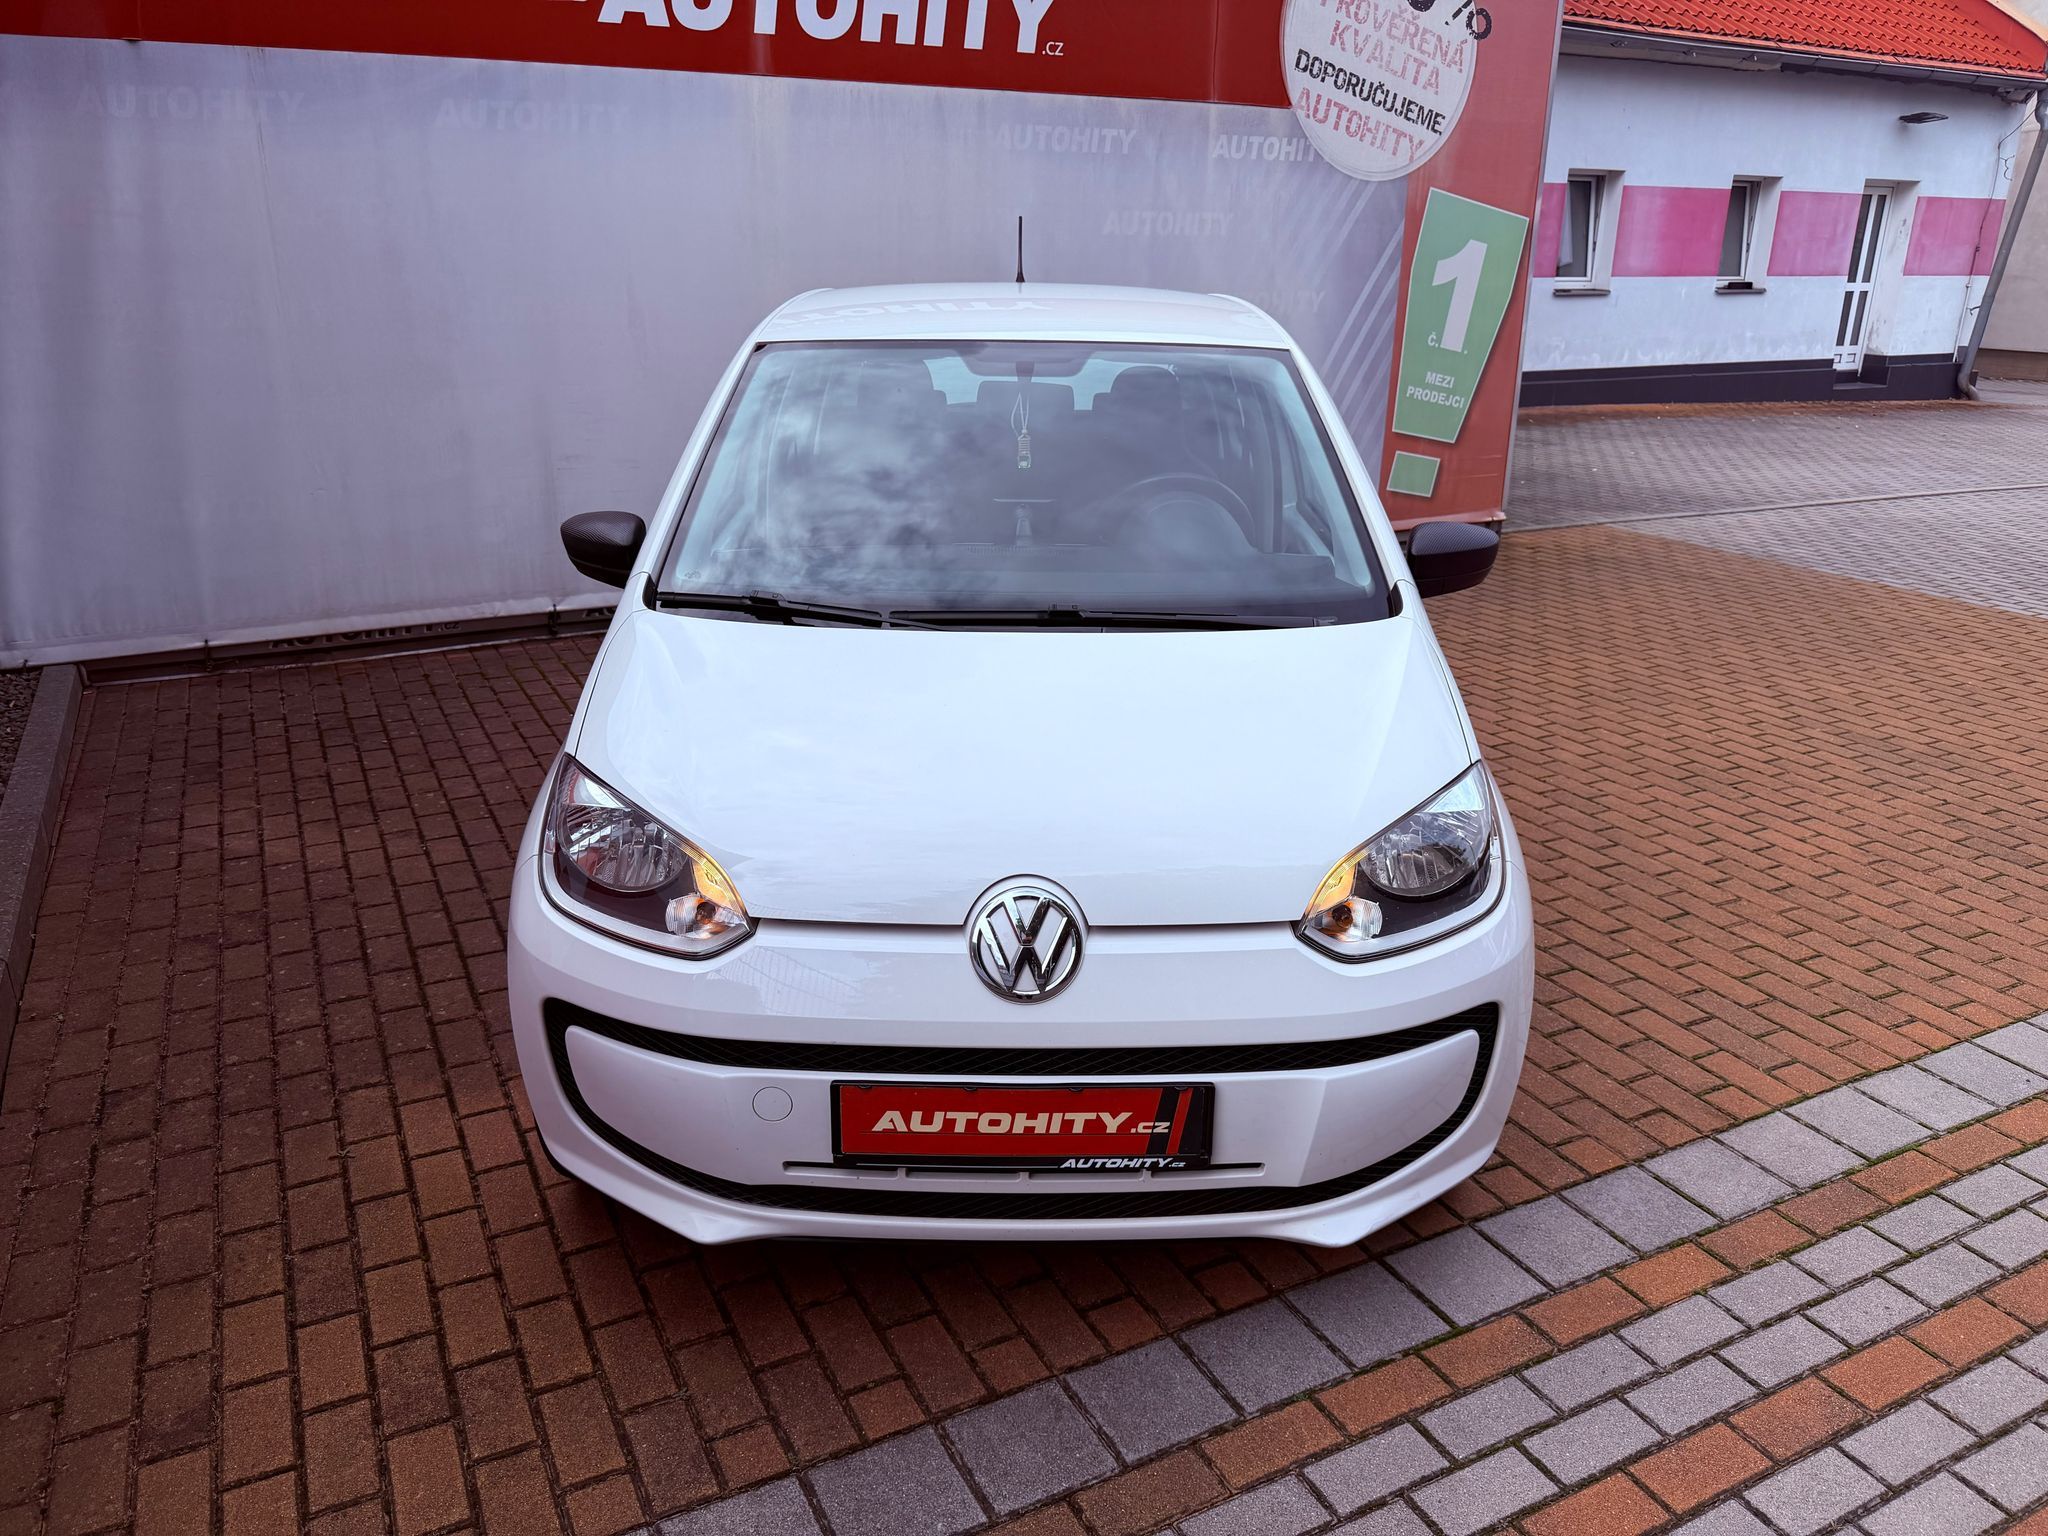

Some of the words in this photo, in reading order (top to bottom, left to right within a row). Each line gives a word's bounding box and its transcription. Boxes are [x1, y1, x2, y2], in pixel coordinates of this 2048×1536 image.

[1320, 0, 1467, 74] ROVĚŘENÁ
[1330, 19, 1441, 96] KVALITA
[1294, 48, 1446, 136] DOPORUČUJEME
[996, 123, 1138, 154] AUTOHITY
[1296, 87, 1426, 163] AUTOHITY
[1211, 135, 1315, 162] AUTOHIT
[1101, 209, 1234, 238] AUTOHITY
[1425, 371, 1455, 388] MEZI
[1406, 385, 1465, 408] PRODEJCI
[871, 1110, 1171, 1135] AUTOHITY.cz
[1059, 1157, 1187, 1169] AUTOHITY.cz
